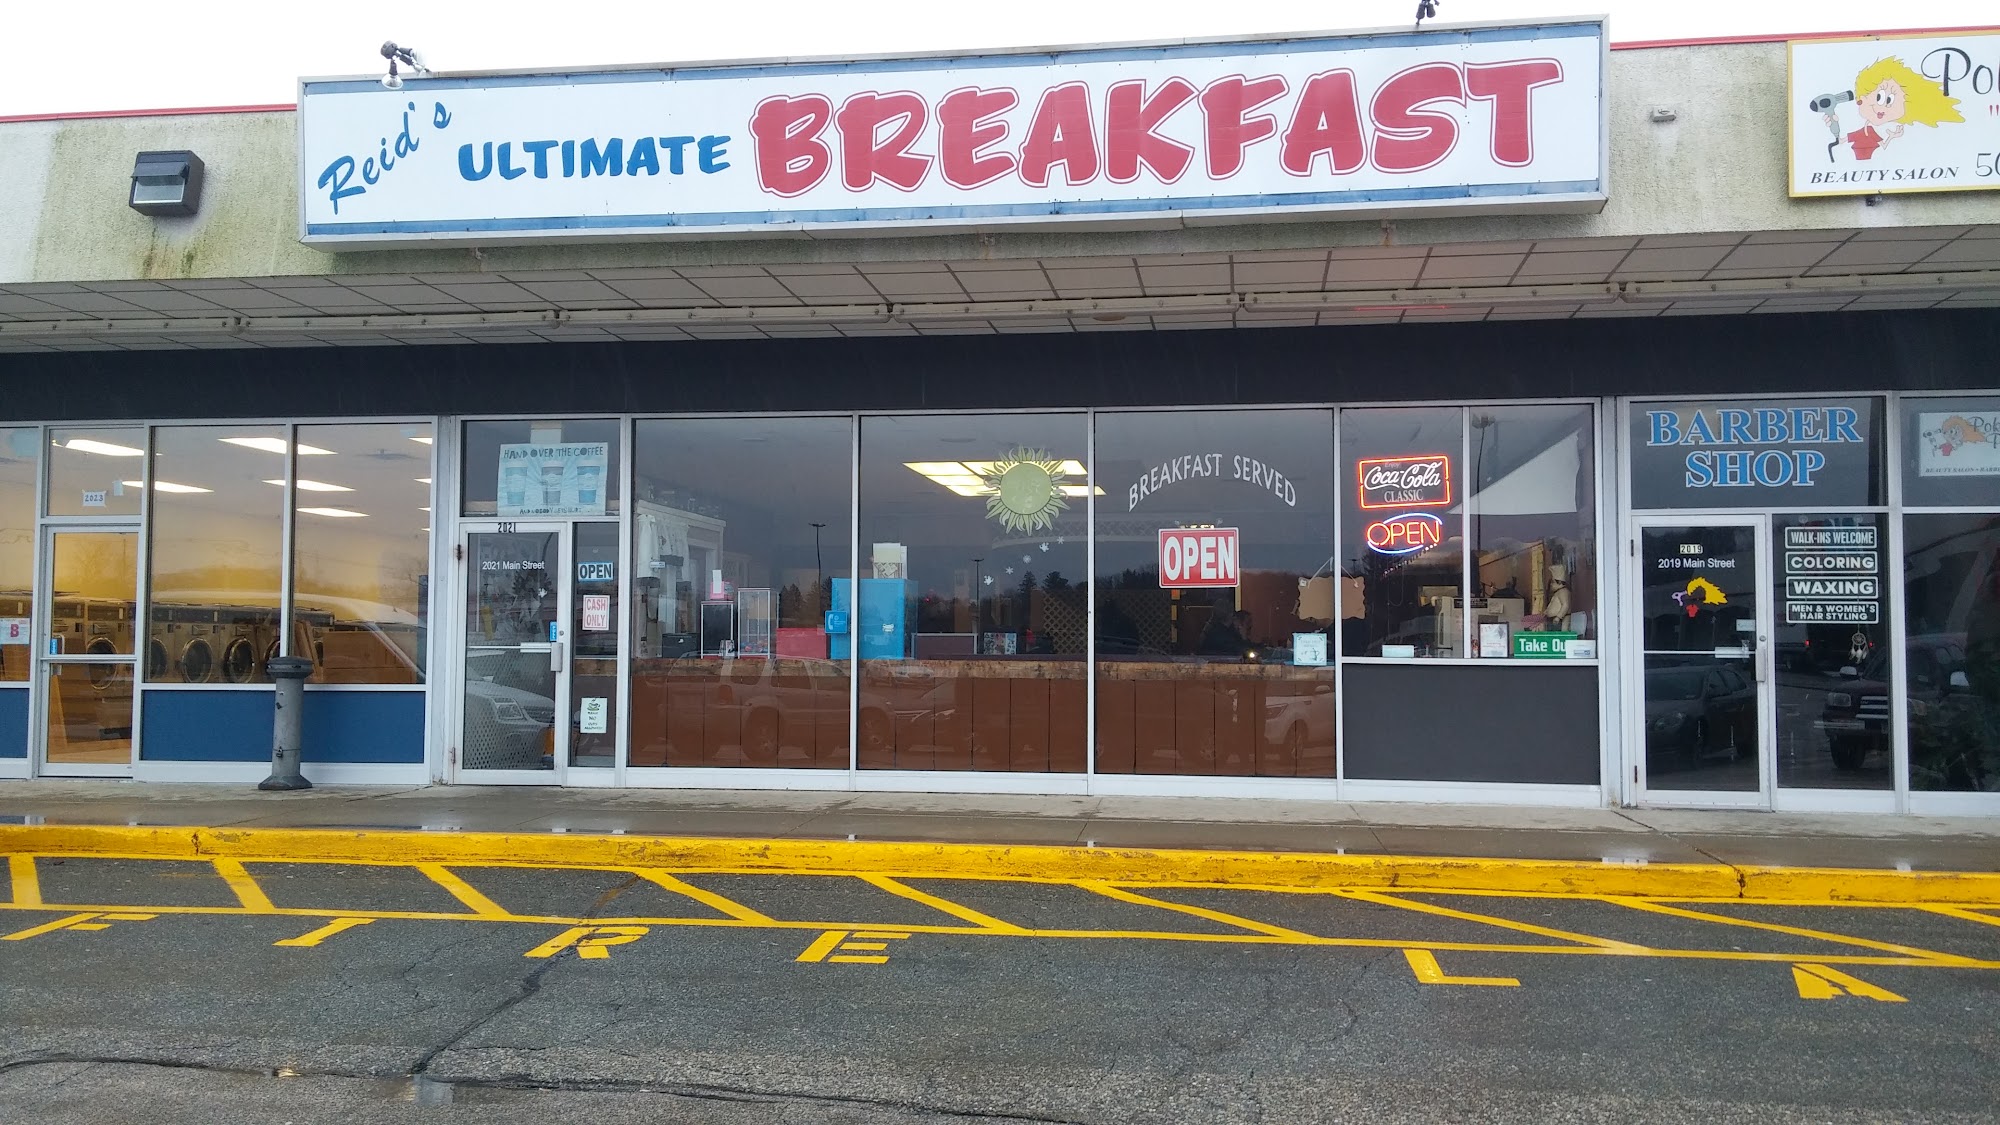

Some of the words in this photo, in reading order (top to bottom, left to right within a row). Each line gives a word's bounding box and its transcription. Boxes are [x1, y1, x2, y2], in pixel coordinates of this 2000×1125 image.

[1921, 47, 2000, 97] Po
[317, 101, 452, 215] Reid's
[458, 135, 732, 181] ULTIMATE
[748, 56, 1564, 199] BREAKFAST
[1810, 169, 1890, 184] BEAUTY
[1892, 167, 1959, 181] SALON
[1646, 407, 1864, 446] BARBER
[503, 449, 528, 460] HAND
[529, 447, 554, 458] OVER
[555, 447, 572, 458] THE
[573, 446, 604, 457] COFFEE
[1364, 461, 1442, 490] Coca-Cola
[1686, 450, 1826, 488] SHOP
[1128, 453, 1223, 513] BREAKFAST
[1233, 454, 1296, 507] SERVED
[84, 494, 104, 502] 2023
[1384, 489, 1424, 503] CLASSIC
[497, 522, 516, 533] 2021
[1367, 521, 1440, 545] OPEN
[1790, 531, 1831, 544] WALK-INS
[1832, 531, 1874, 544] WELCOME
[1681, 545, 1703, 554] 2019
[482, 561, 500, 570] 2021
[502, 561, 520, 570] Main
[522, 560, 545, 570] Street
[1163, 535, 1235, 581] OPEN
[1658, 558, 1681, 569] 2019
[1683, 558, 1706, 568] Main
[1707, 558, 1735, 568] Street
[1790, 556, 1875, 569] COLORING
[579, 563, 612, 579] OPEN
[1793, 581, 1874, 595] WAXING
[586, 598, 606, 610] CASH
[1791, 604, 1813, 613] MEN
[1815, 604, 1823, 613] &
[1825, 604, 1875, 613] WOMEN'S
[586, 613, 606, 627] ONLY
[1799, 612, 1824, 620] HAIR
[1825, 612, 1868, 620] STYLING
[1519, 638, 1548, 652] Take
[1552, 638, 1567, 652] Ou
